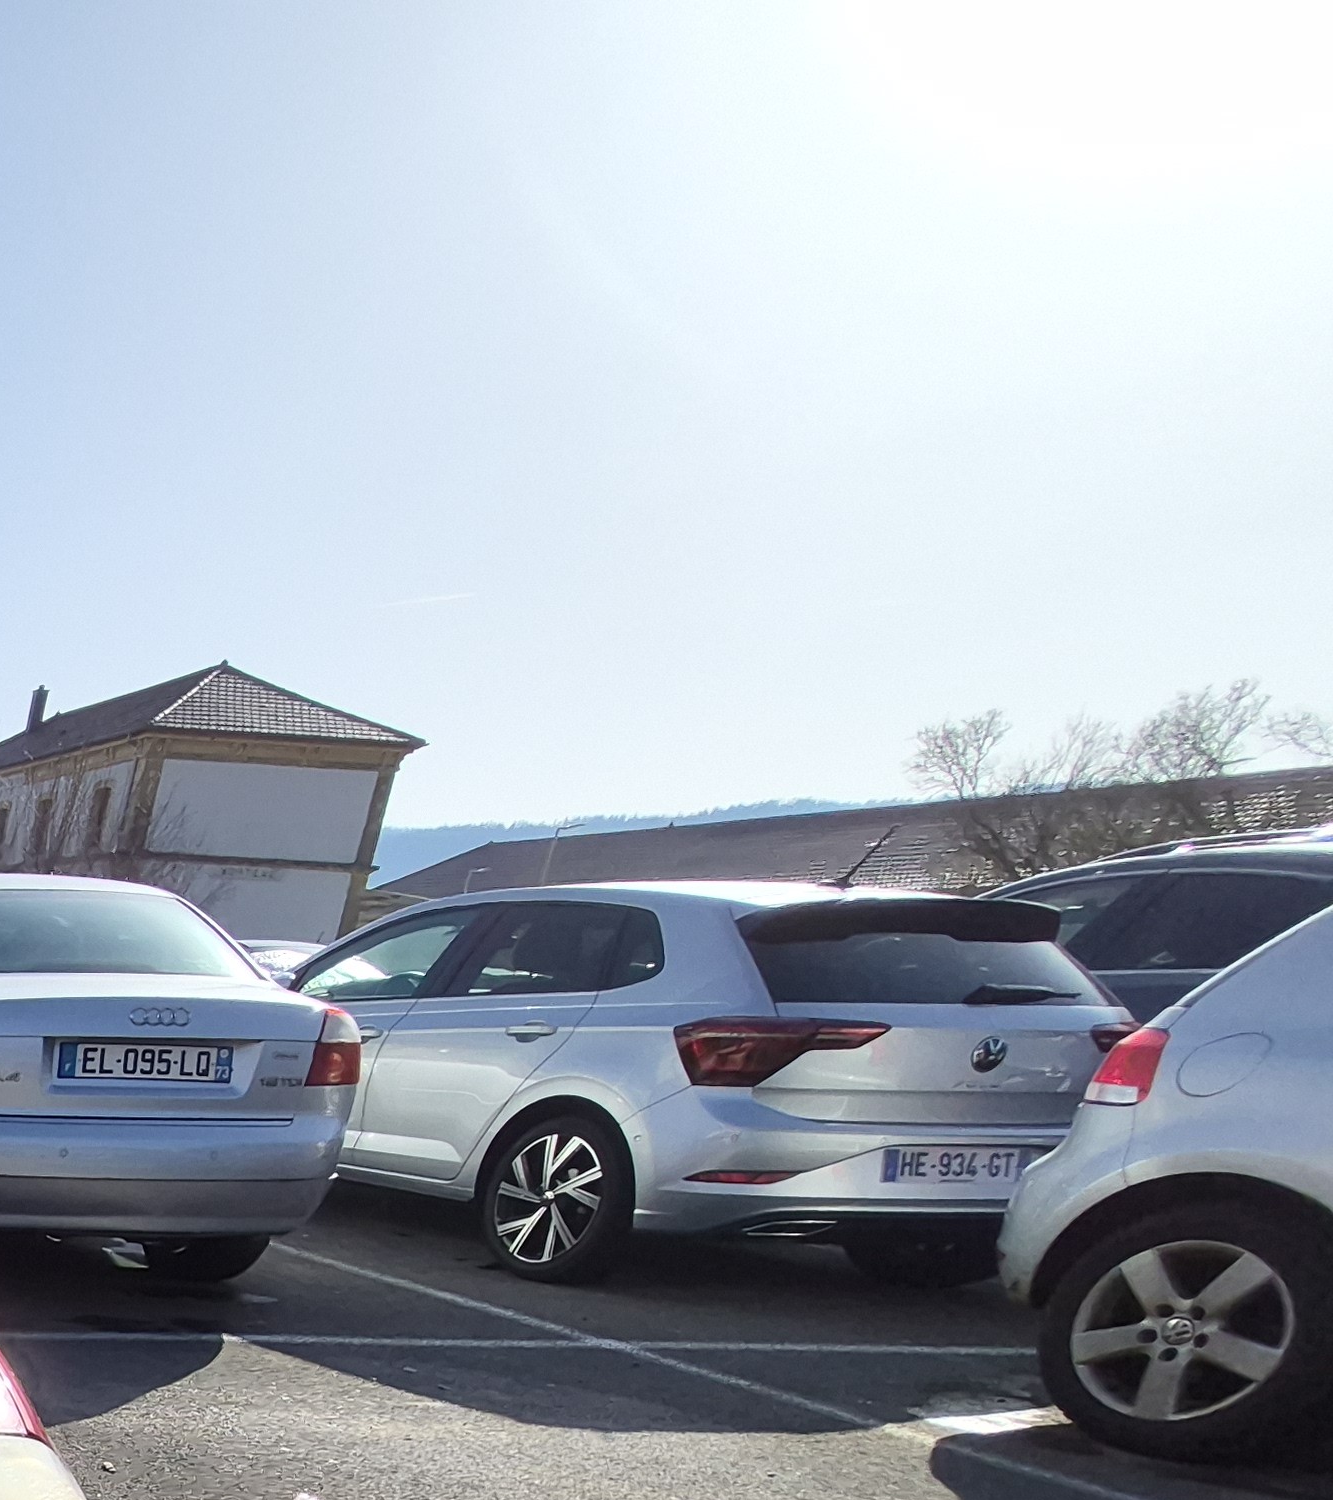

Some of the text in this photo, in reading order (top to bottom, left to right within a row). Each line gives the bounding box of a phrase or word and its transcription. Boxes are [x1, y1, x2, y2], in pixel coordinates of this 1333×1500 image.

[82, 1047, 211, 1077] EL-095-LQ
[215, 1065, 230, 1079] 73
[899, 1152, 1015, 1178] HE-934-GT
